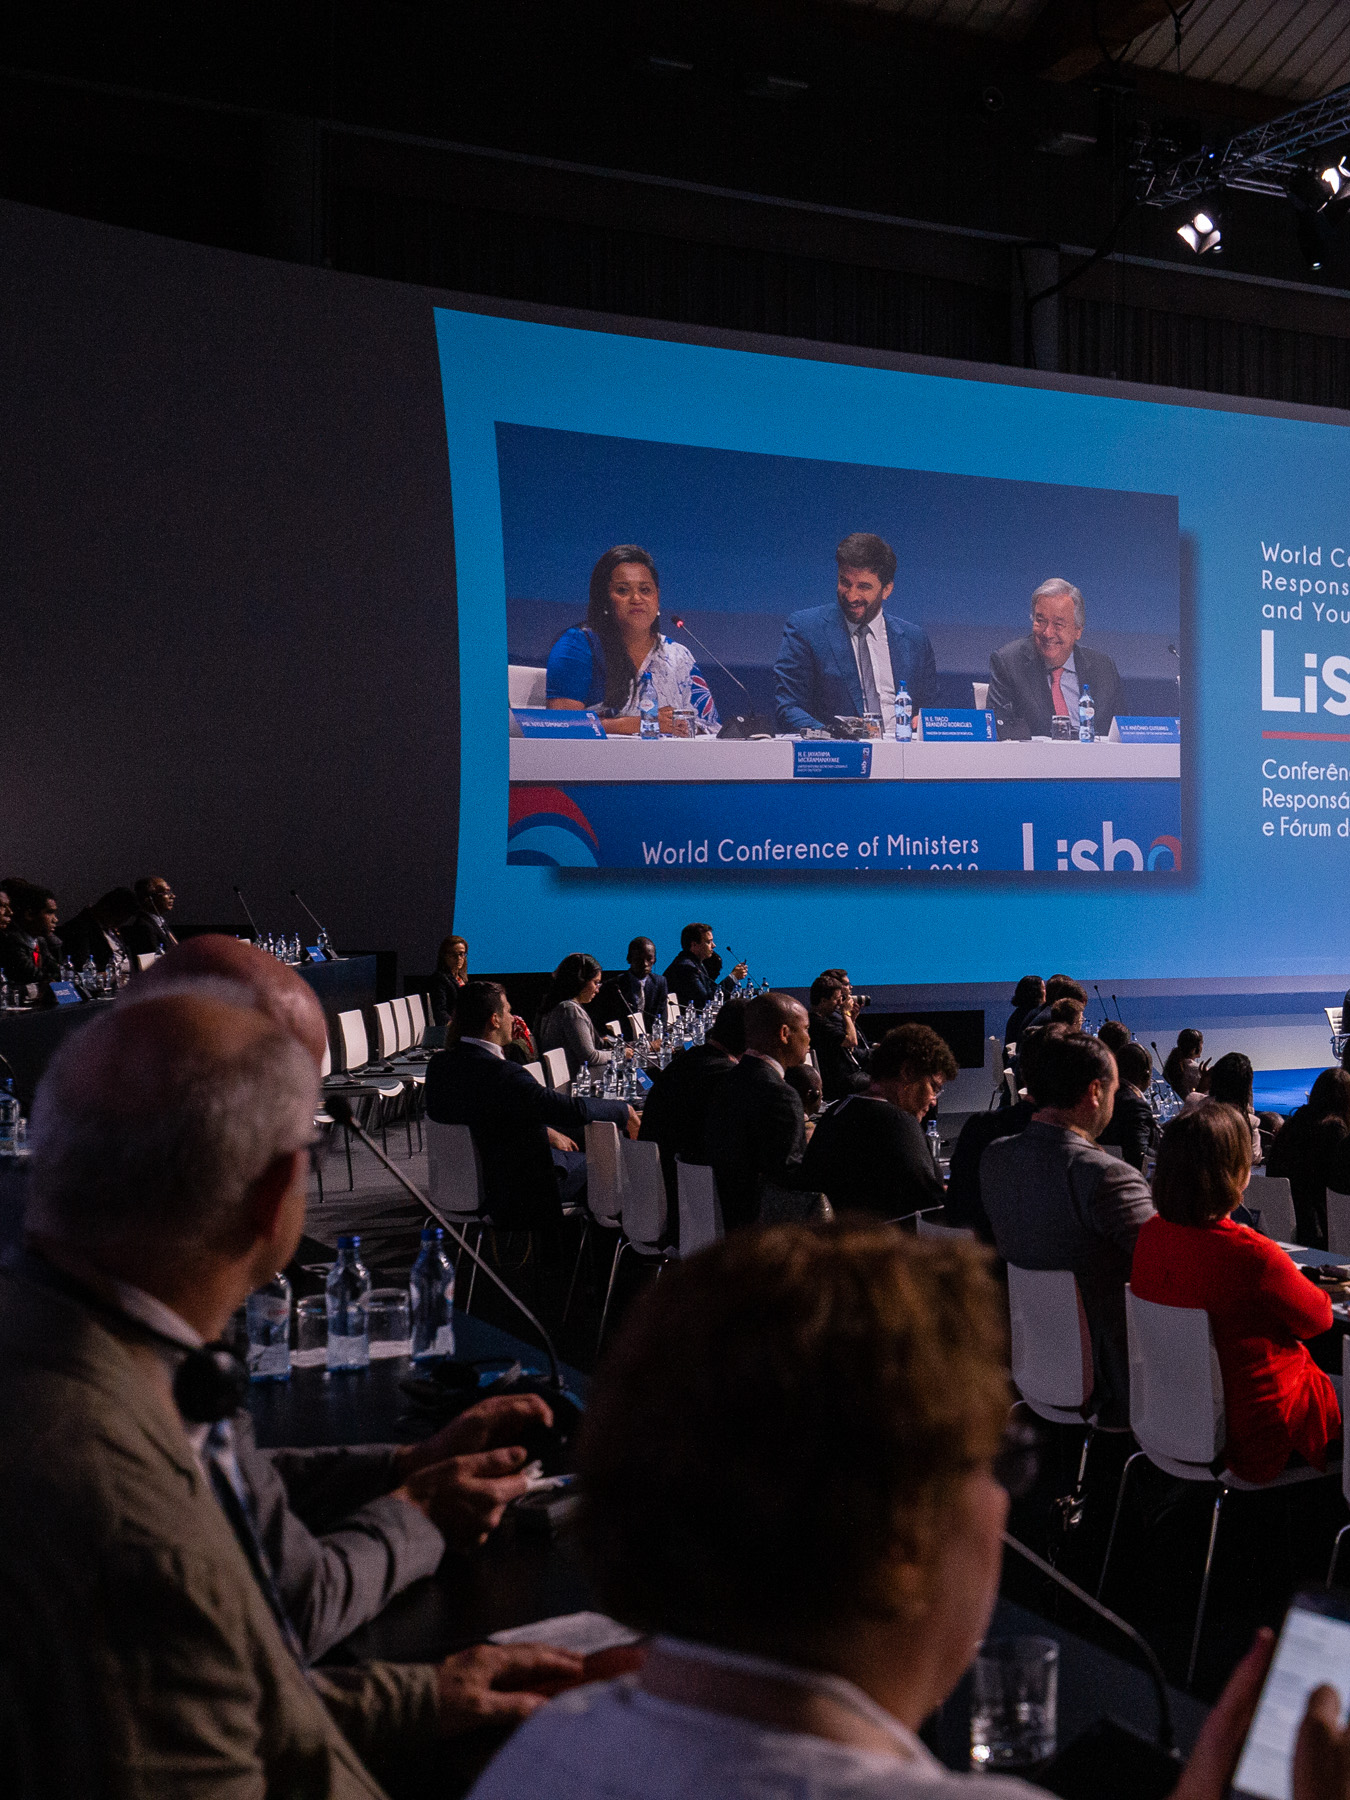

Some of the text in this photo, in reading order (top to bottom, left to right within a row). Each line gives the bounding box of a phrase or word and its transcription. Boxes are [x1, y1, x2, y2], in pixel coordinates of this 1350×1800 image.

[1261, 541, 1321, 565] World
[1262, 601, 1302, 621] and
[1262, 820, 1274, 836] e
[1280, 817, 1331, 837] Fórum
[642, 834, 979, 865] World Conference of Ministers
